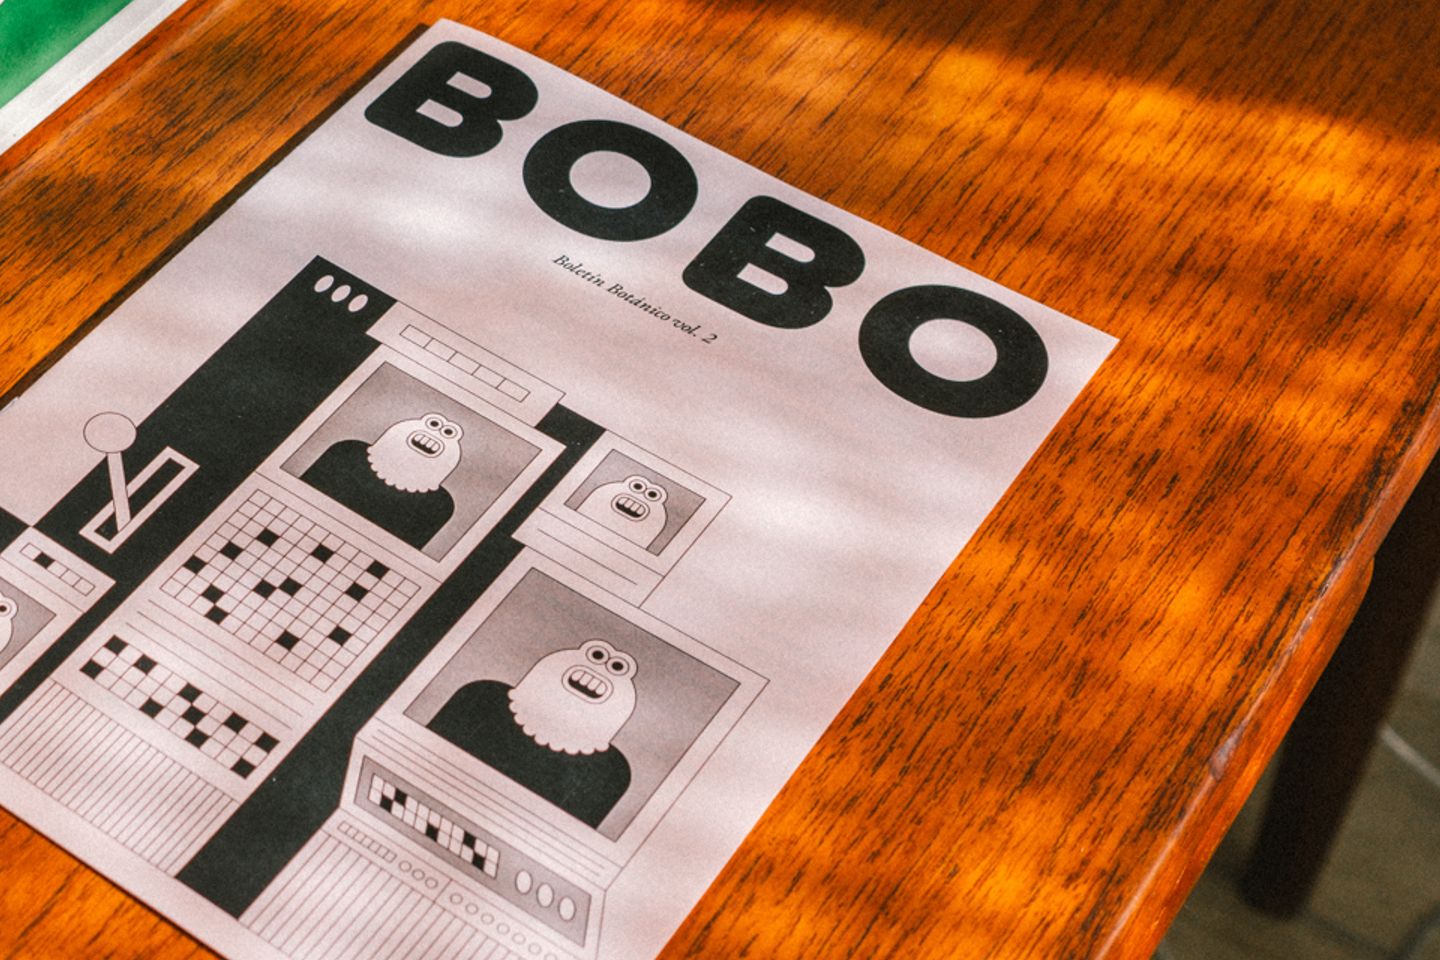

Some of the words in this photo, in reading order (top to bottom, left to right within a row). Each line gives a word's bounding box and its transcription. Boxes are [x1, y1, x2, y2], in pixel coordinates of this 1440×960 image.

[364, 40, 1050, 419] BOBO
[552, 254, 606, 288] Boletín
[606, 282, 671, 322] Botánico
[671, 317, 701, 338] vol.
[701, 332, 719, 345] 2
